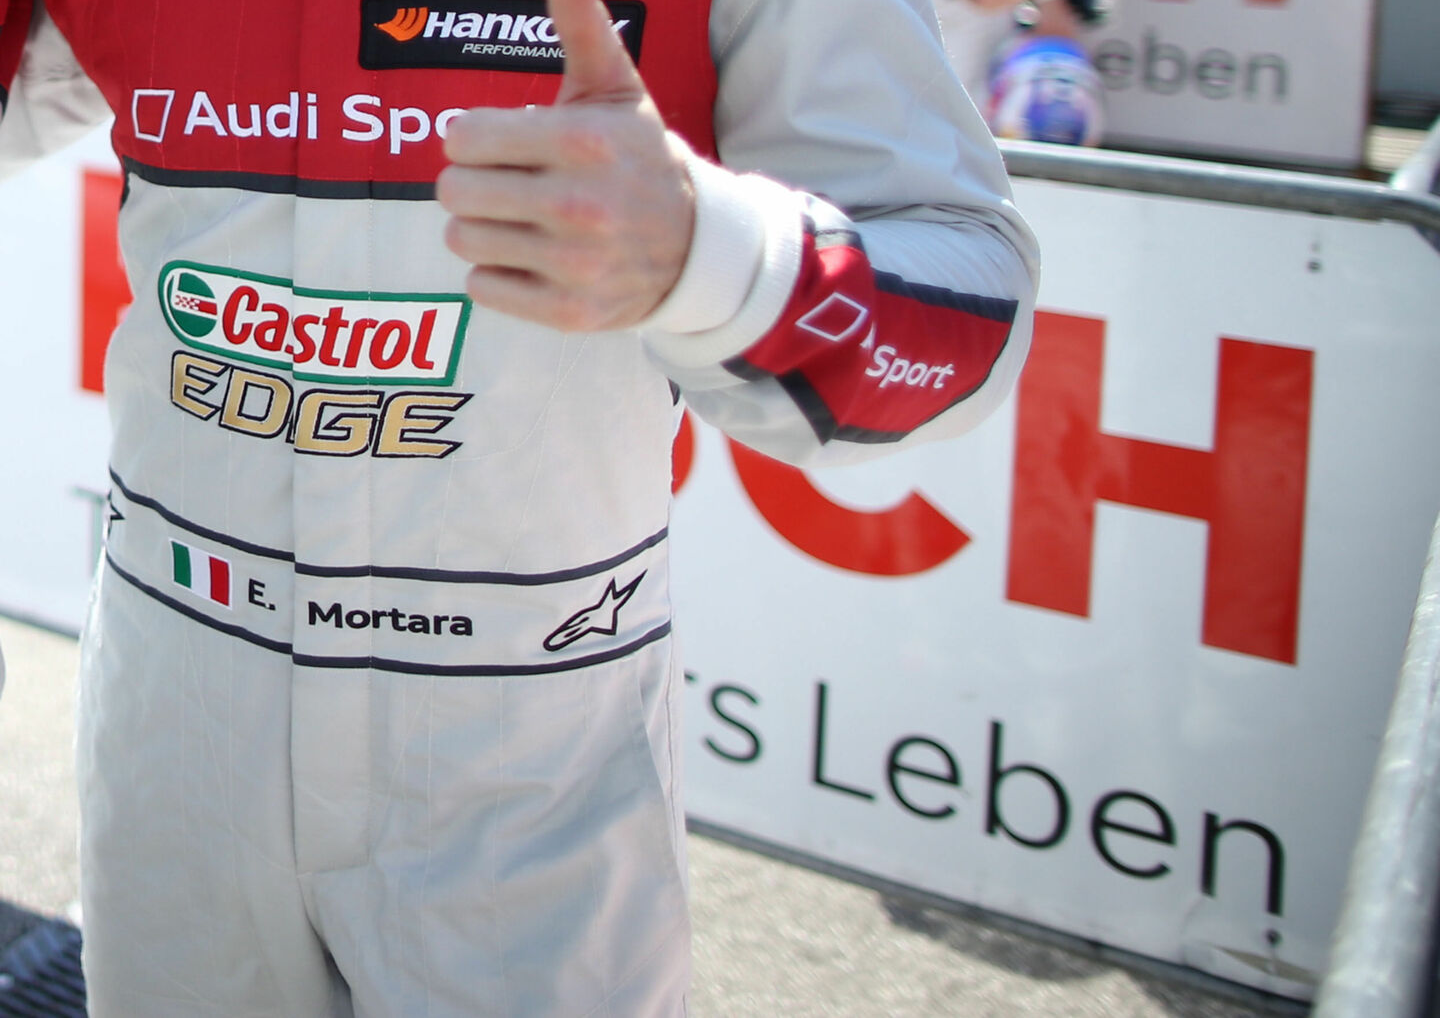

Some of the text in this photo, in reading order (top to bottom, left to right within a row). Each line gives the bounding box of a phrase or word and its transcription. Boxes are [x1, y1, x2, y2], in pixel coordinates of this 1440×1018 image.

[184, 90, 317, 139] Audi
[222, 285, 438, 371] Castrol
[864, 344, 955, 389] Sport
[169, 349, 475, 459] EDGE
[247, 578, 474, 637] E. Mortara
[811, 681, 1285, 918] Leben
